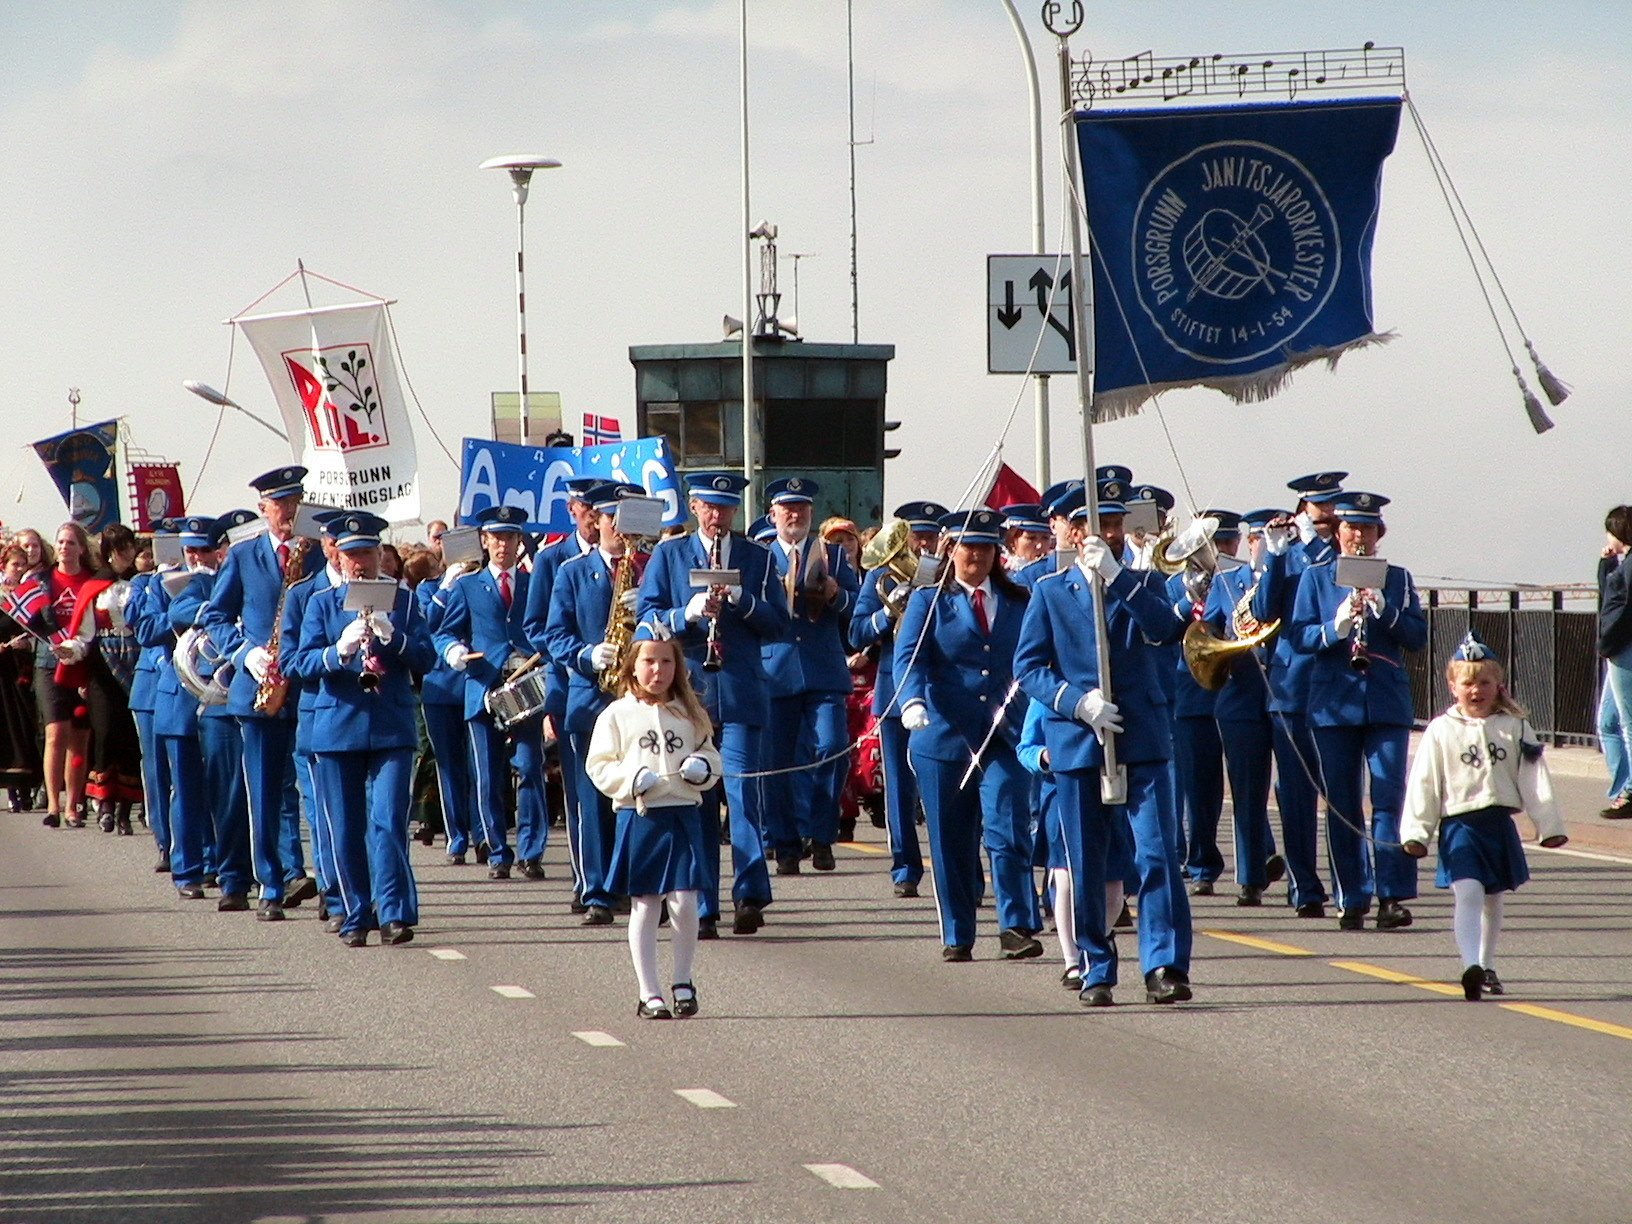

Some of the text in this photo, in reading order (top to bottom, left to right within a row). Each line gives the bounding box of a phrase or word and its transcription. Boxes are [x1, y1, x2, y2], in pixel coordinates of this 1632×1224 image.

[1145, 187, 1188, 306] PORSGRUNN
[1171, 305, 1293, 344] STIFTET 14-1-54
